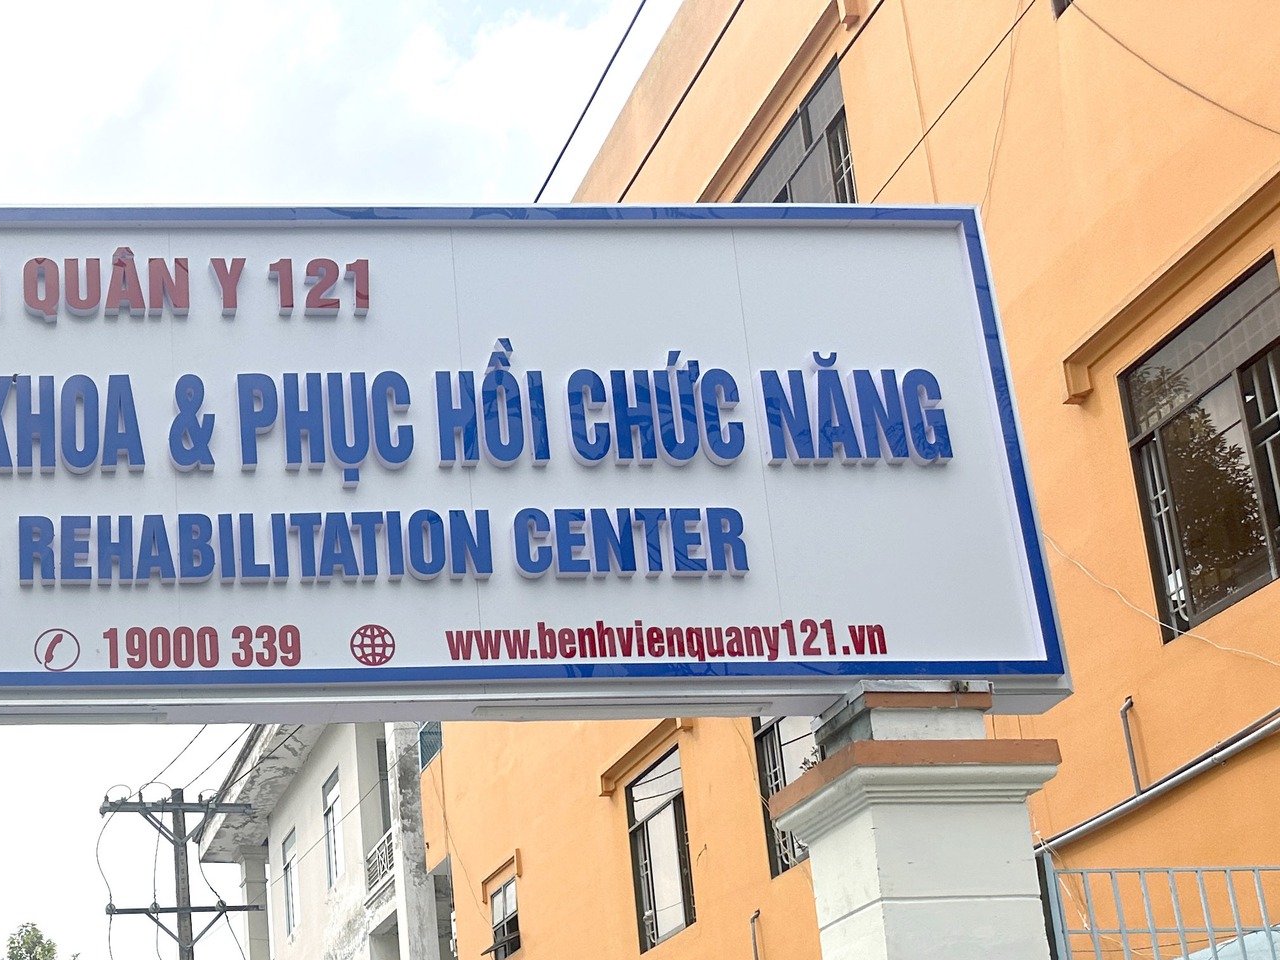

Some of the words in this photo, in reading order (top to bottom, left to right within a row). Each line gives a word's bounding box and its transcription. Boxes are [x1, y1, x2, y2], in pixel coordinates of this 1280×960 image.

[23, 247, 190, 325] QUÂN
[210, 257, 247, 316] Y
[268, 257, 371, 316] 121
[169, 373, 215, 473] &
[236, 370, 414, 489] PHỤC
[435, 337, 551, 468] HỒI
[567, 350, 745, 466] CHỨC
[760, 350, 954, 466] NĂNG
[19, 509, 494, 585] REHABILITATION
[513, 507, 750, 582] CENTER
[102, 626, 220, 669] 19000
[231, 624, 302, 668] 339
[445, 617, 888, 662] www.benhvienquany121.vn
